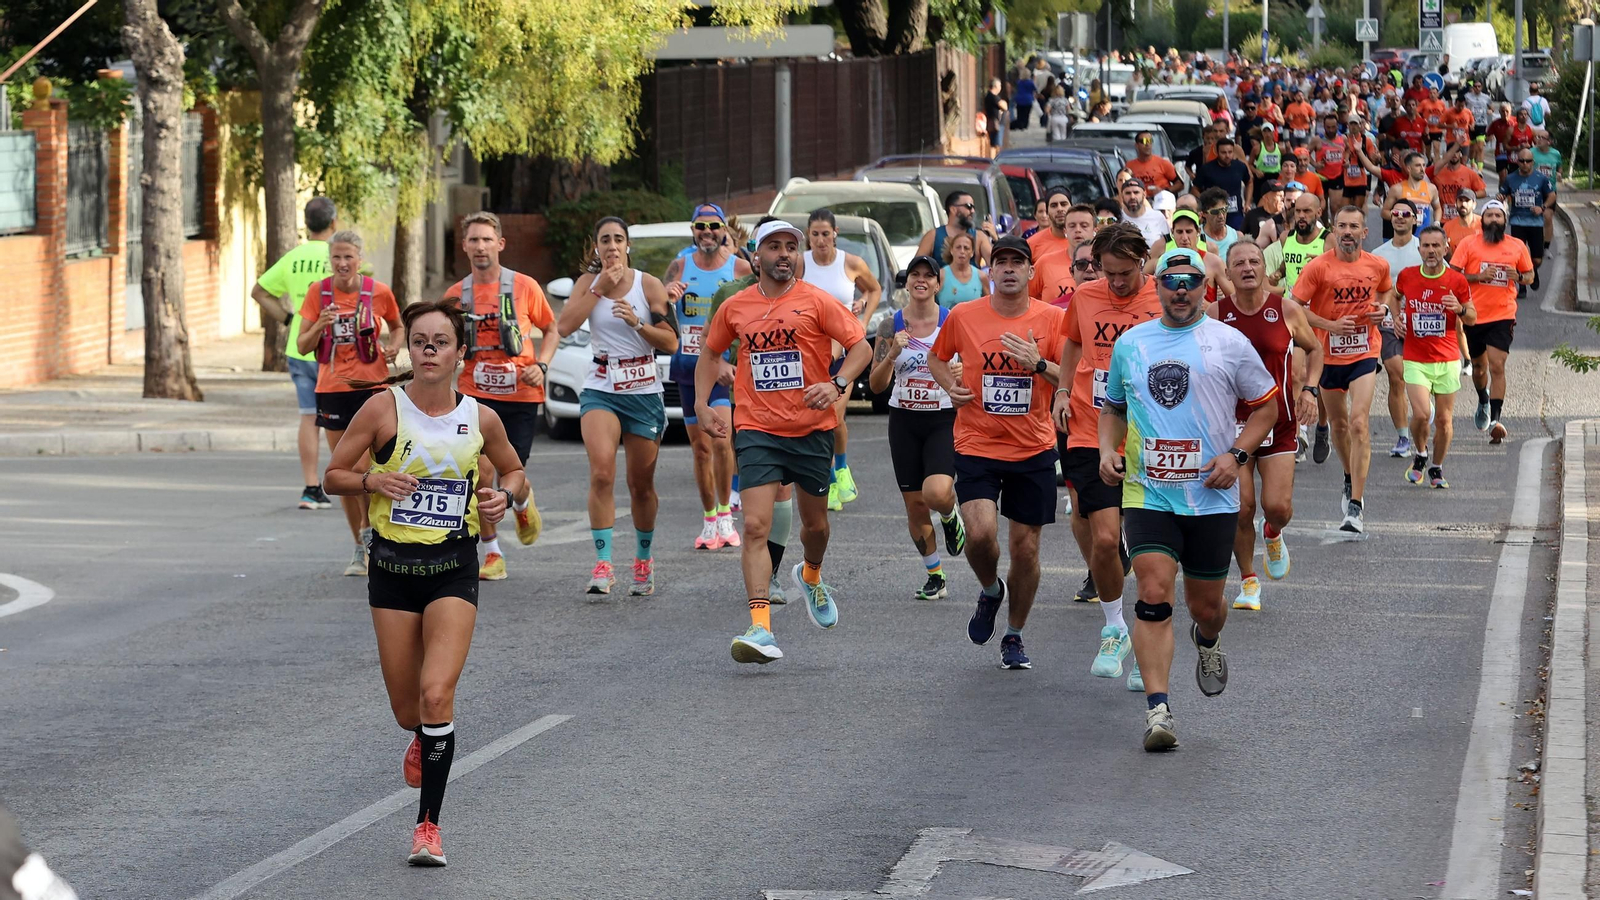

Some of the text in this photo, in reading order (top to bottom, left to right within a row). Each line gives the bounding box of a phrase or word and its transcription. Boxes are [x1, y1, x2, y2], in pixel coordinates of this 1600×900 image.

[1285, 252, 1302, 264] BRO
[1333, 286, 1371, 300] XXIX
[1409, 299, 1446, 311] sherry
[1418, 321, 1441, 330] 1068
[745, 328, 797, 350] XXIX
[1340, 335, 1359, 346] 305
[623, 367, 646, 380] 190
[763, 364, 789, 378] 610
[484, 374, 506, 385] 352
[907, 388, 929, 400] 182
[994, 389, 1019, 402] 661
[1157, 453, 1187, 467] 217
[411, 492, 448, 513] 915
[412, 565, 427, 577] ES
[428, 558, 460, 576] TRAIL
